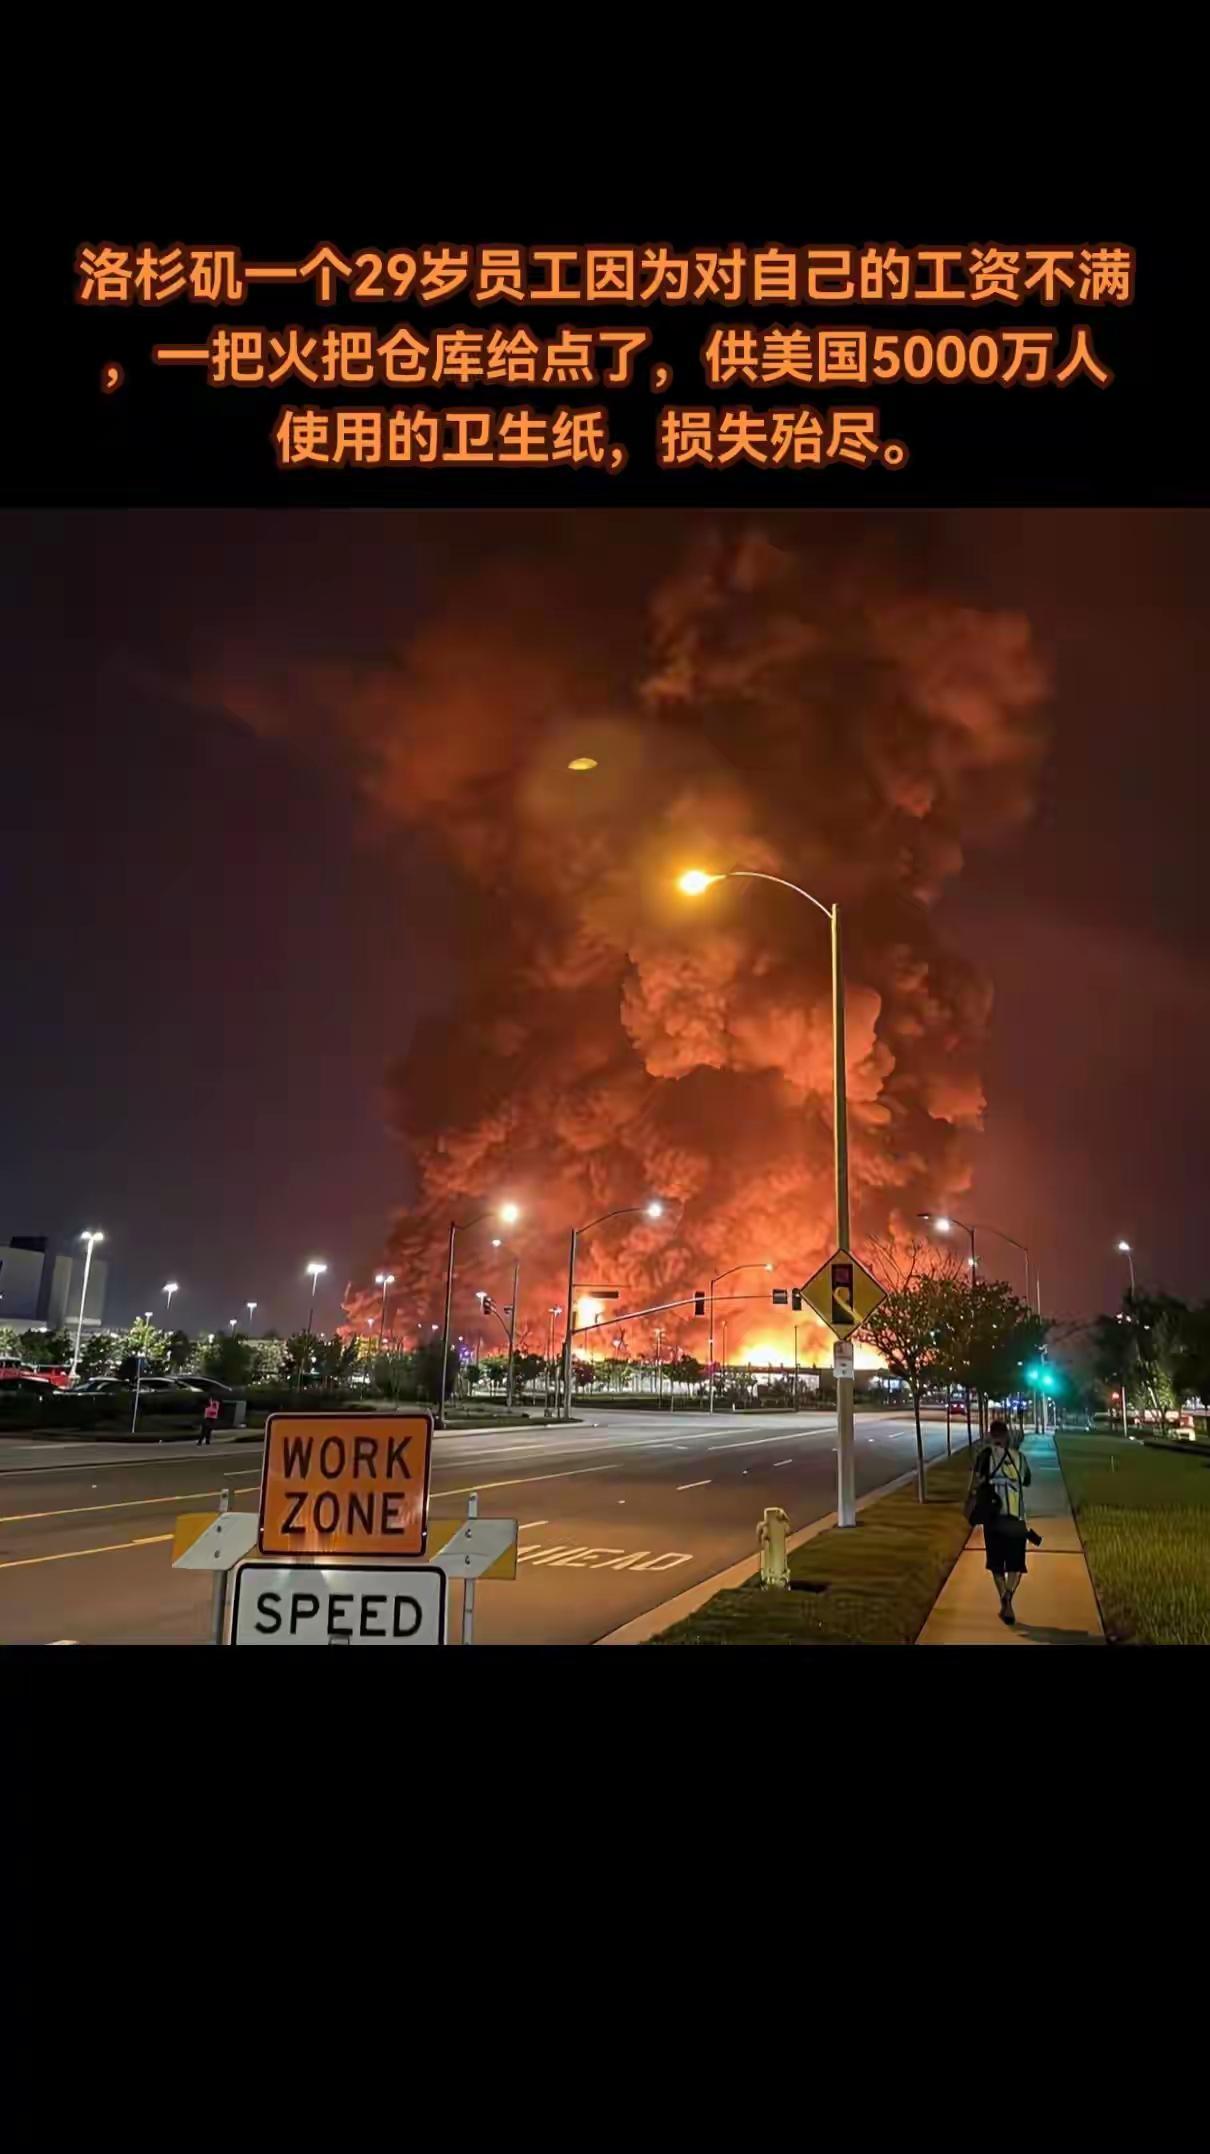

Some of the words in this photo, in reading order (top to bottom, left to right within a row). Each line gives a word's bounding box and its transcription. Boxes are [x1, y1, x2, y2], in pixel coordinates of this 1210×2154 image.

[283, 1435, 413, 1480] WORK
[281, 1490, 405, 1536] ZONE
[254, 1592, 423, 1638] SPEED
